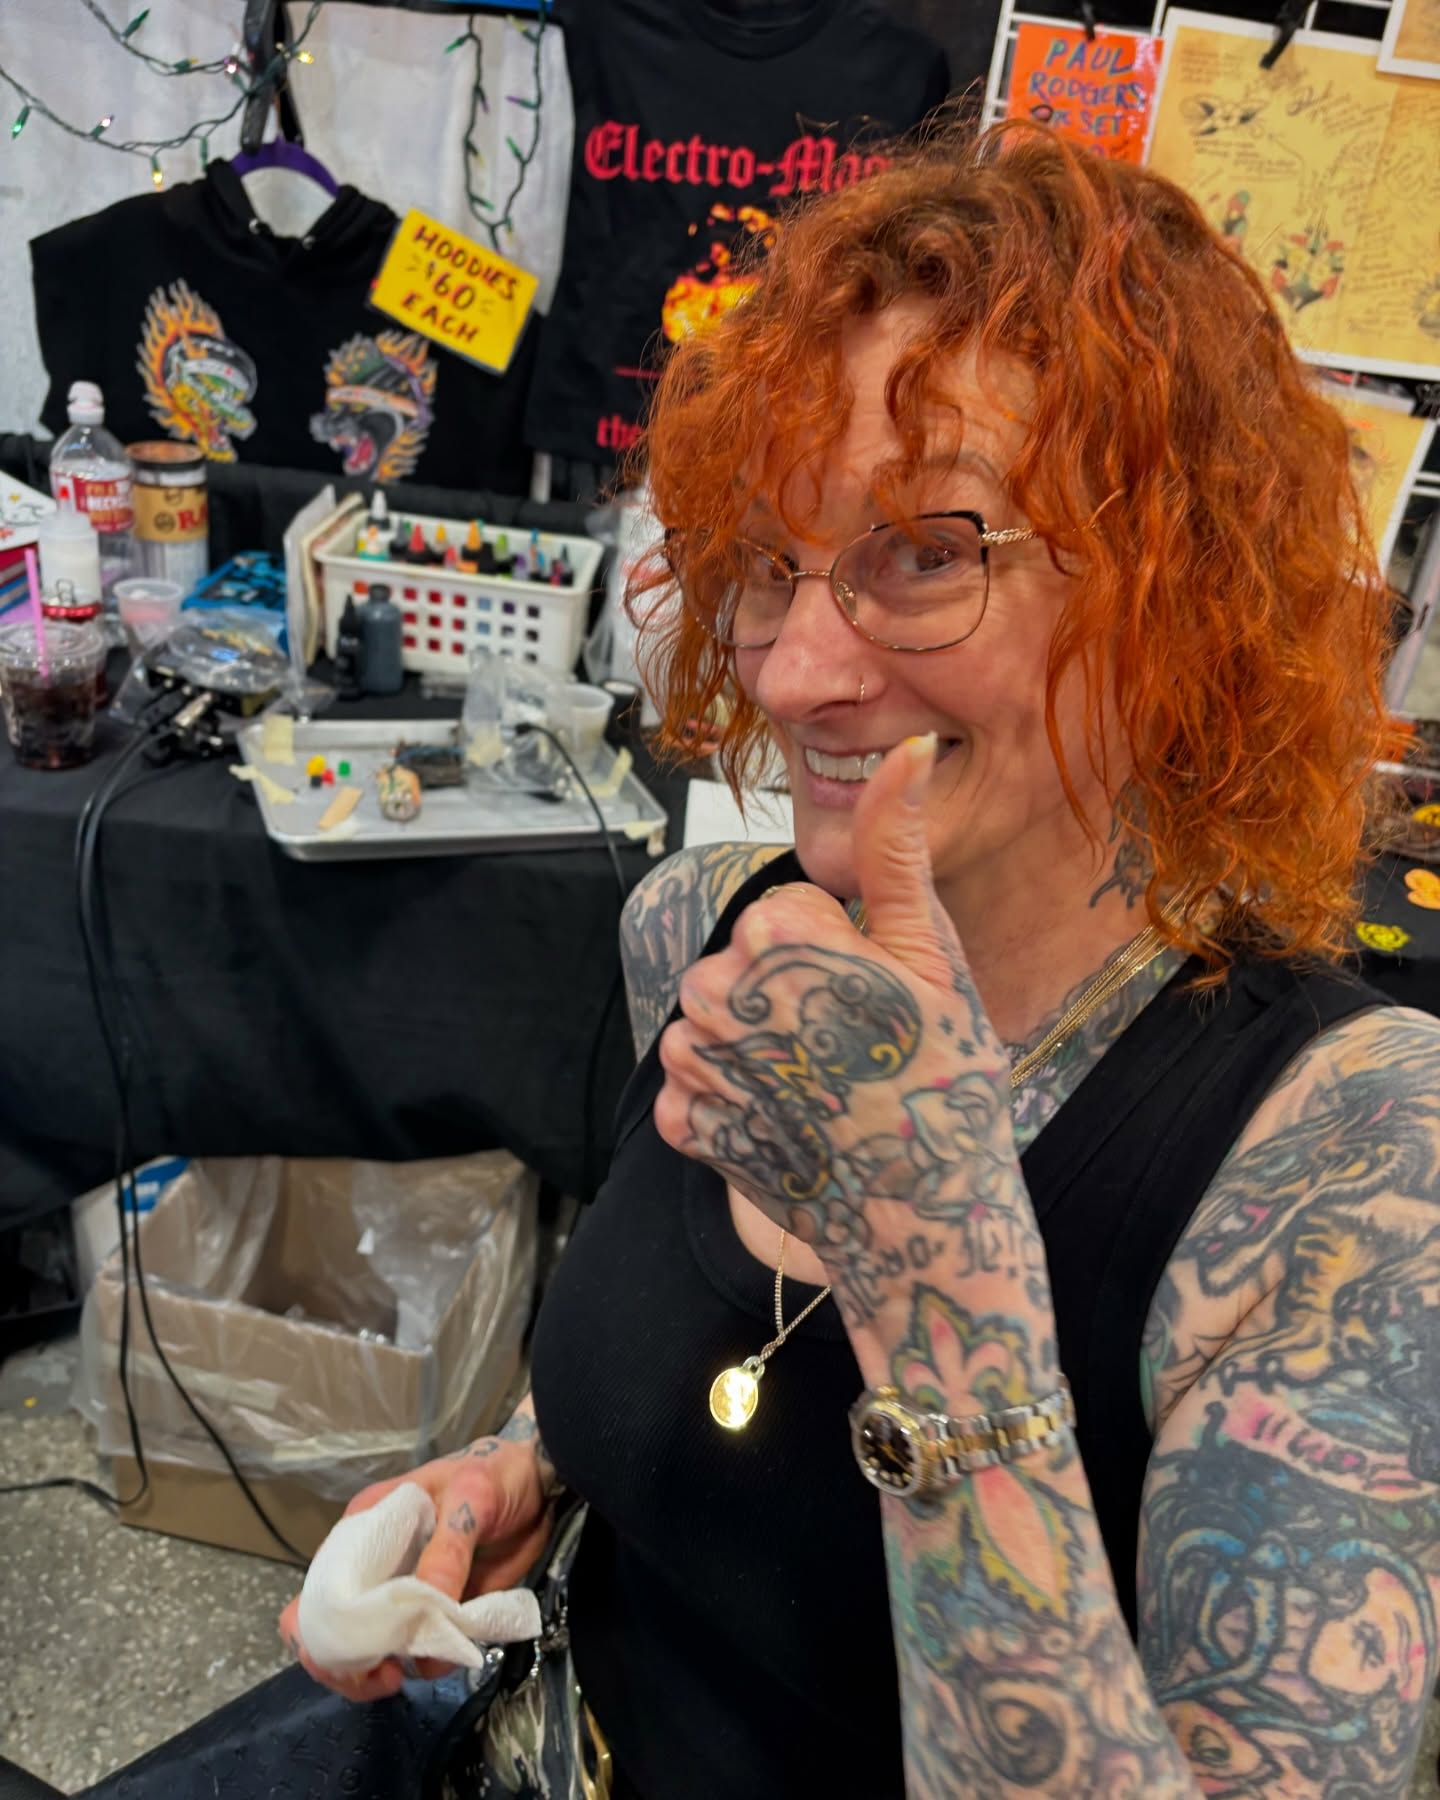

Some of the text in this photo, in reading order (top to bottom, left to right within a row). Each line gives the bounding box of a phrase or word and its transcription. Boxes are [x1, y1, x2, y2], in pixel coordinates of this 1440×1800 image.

[1045, 38, 1134, 77] PAUL
[1028, 70, 1146, 113] RODGERS
[1079, 110, 1125, 138] SET
[413, 224, 520, 302] HOODIES
[400, 290, 480, 344] EACH
